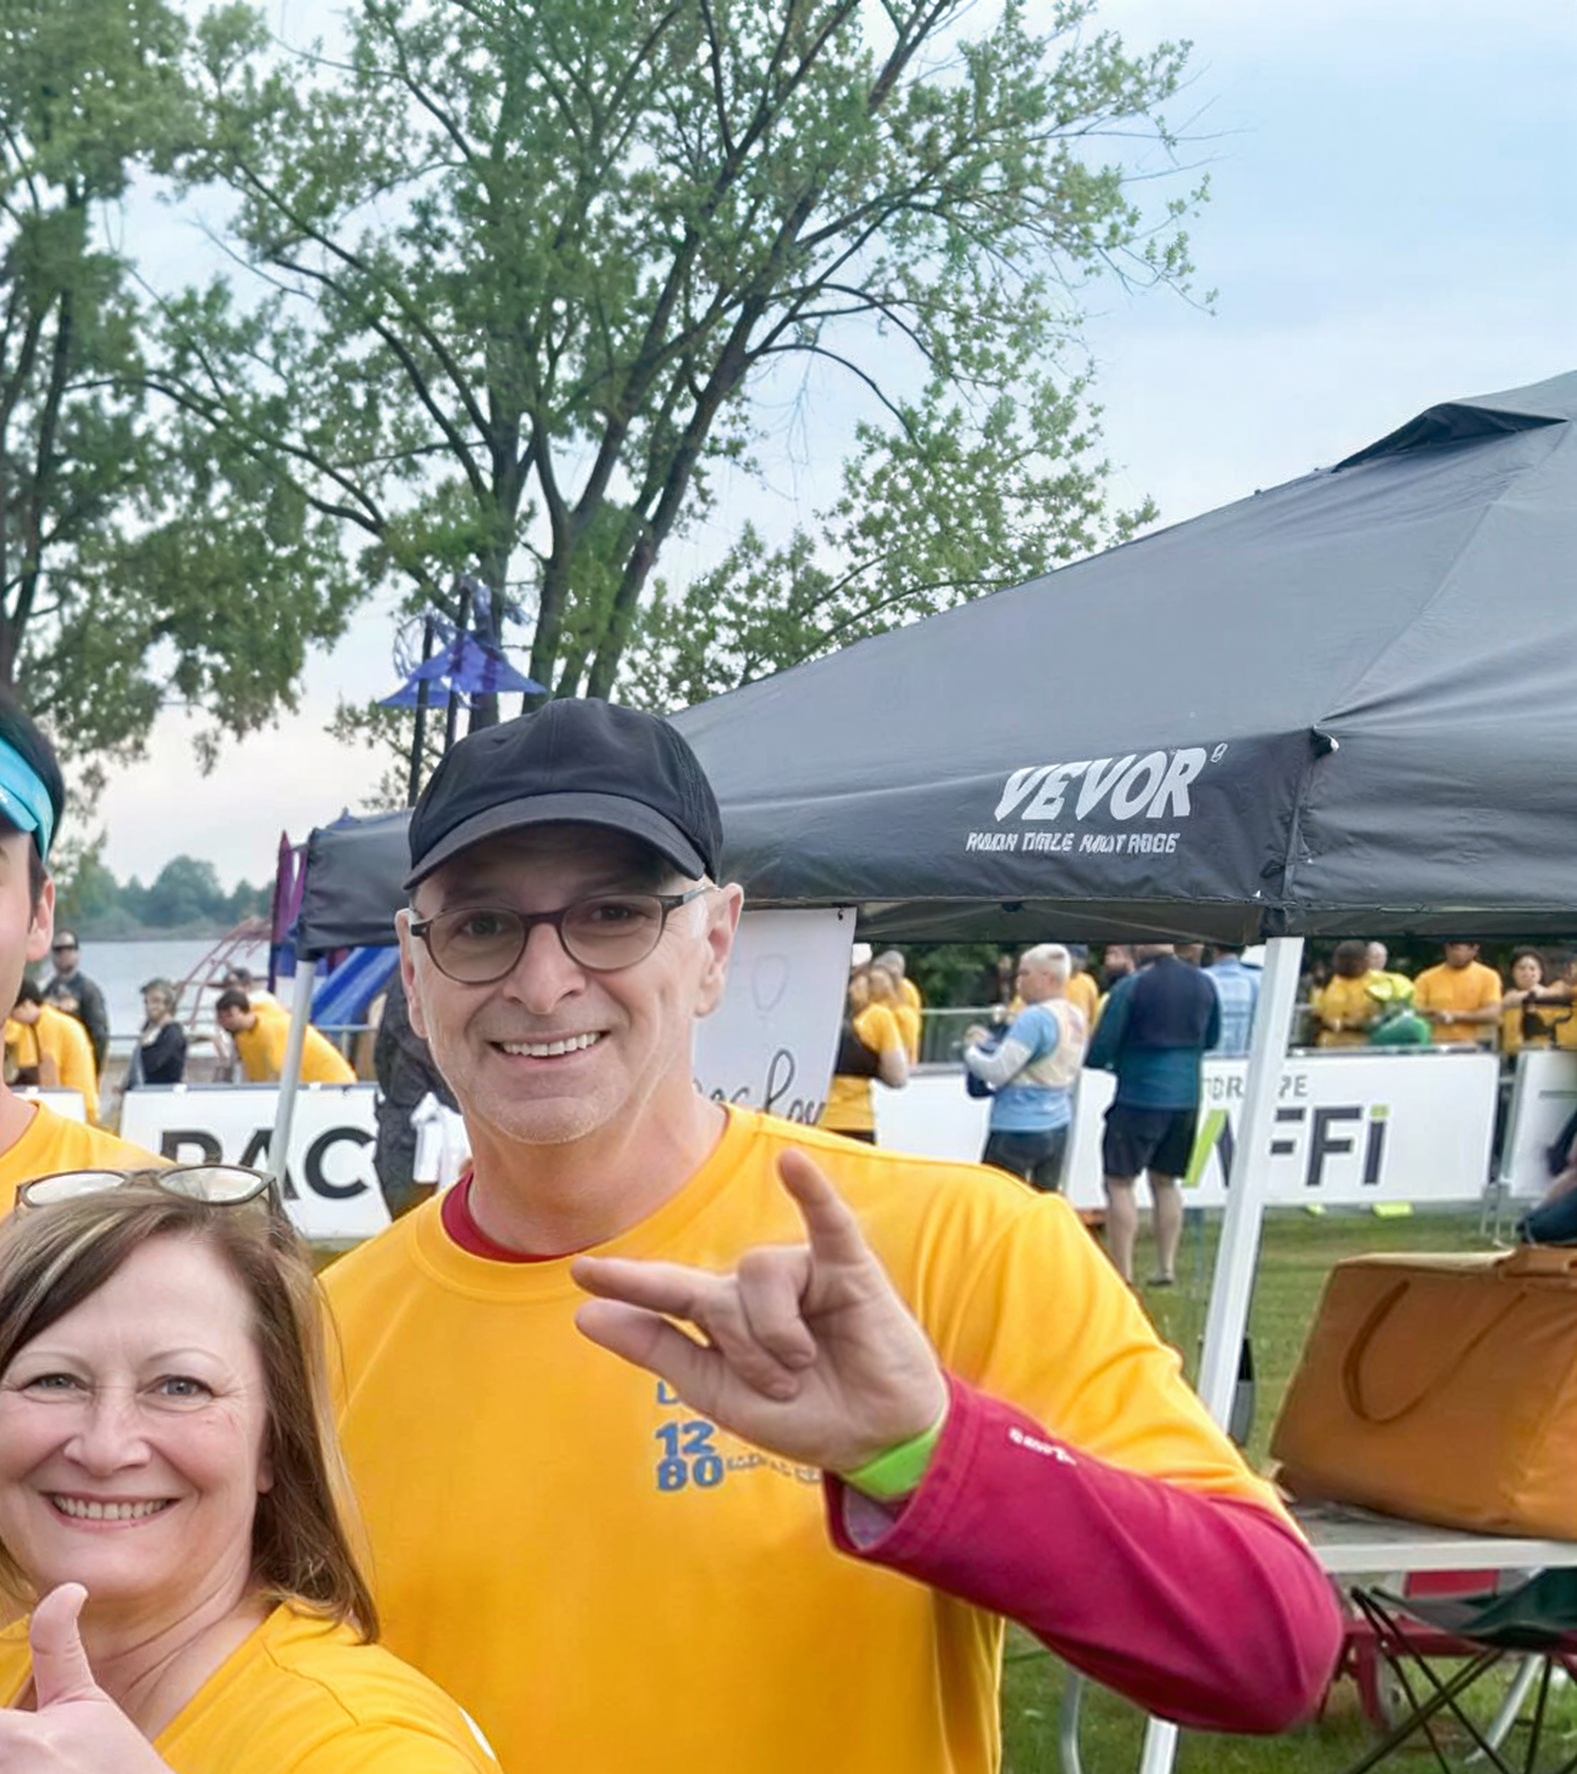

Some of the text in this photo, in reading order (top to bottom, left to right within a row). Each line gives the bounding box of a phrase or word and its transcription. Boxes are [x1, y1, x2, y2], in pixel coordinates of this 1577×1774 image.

[994, 746, 1208, 822] VEVOR
[655, 1420, 715, 1457] 12
[657, 1455, 724, 1491] 80
